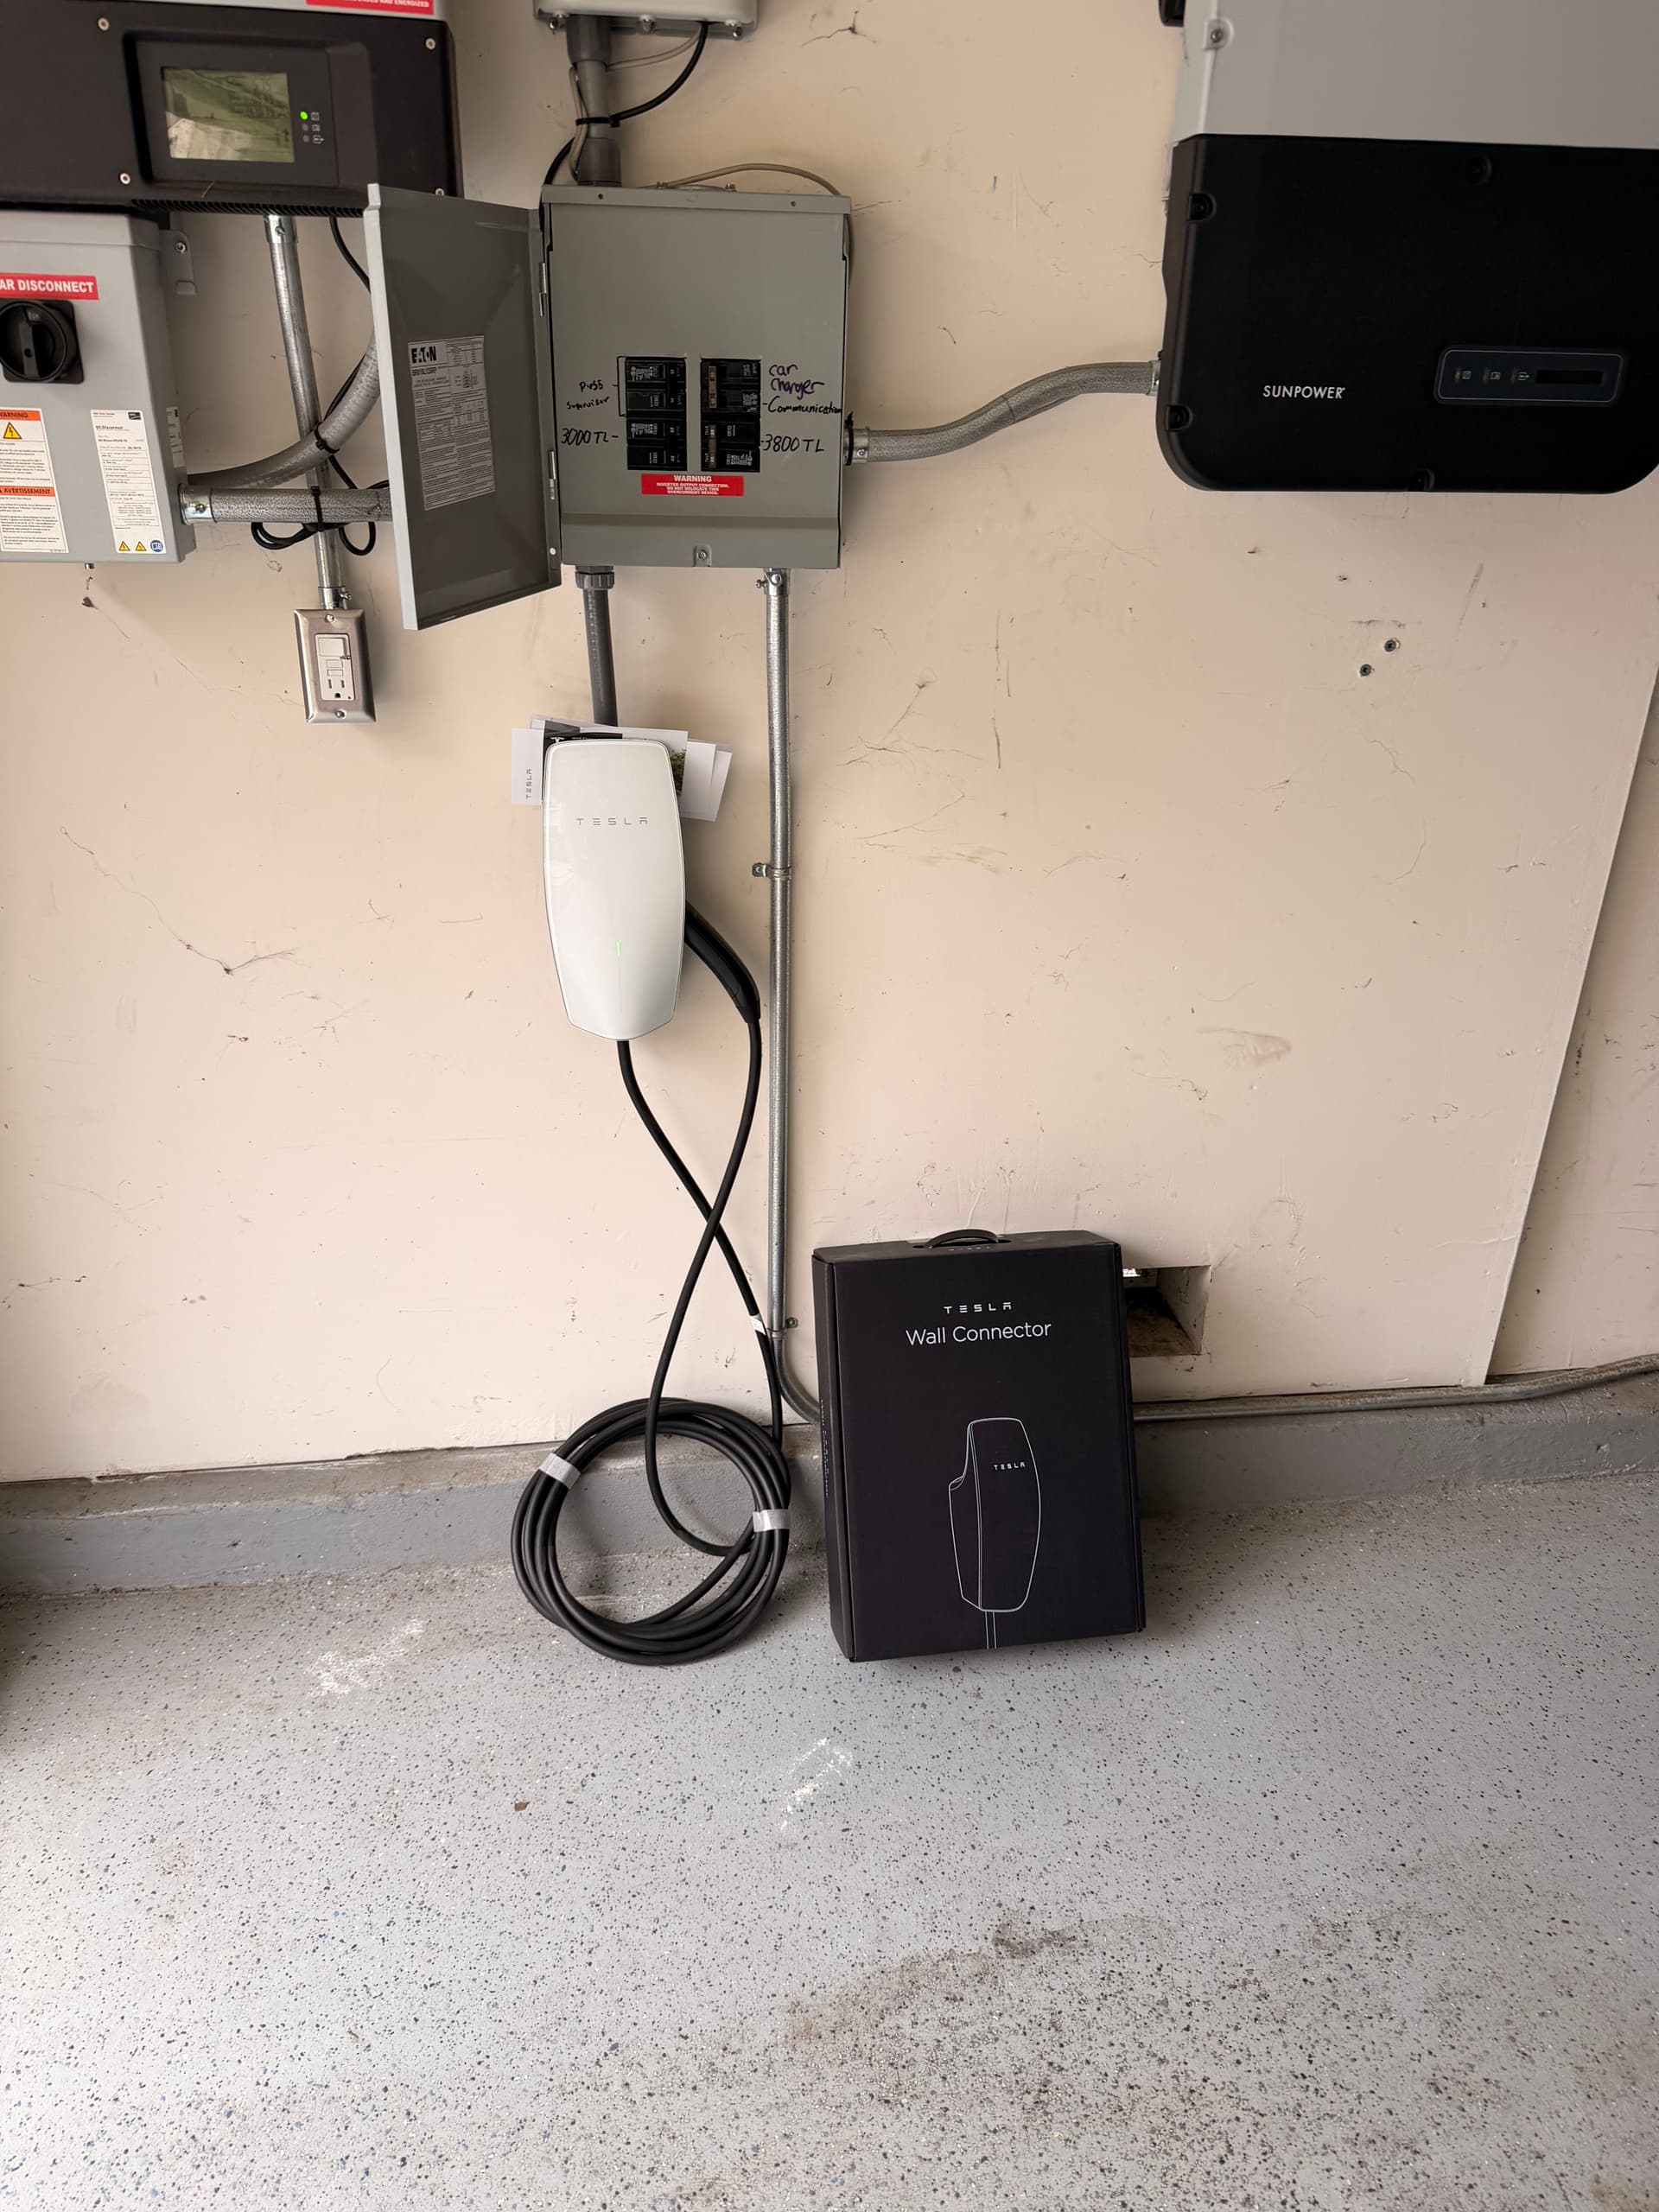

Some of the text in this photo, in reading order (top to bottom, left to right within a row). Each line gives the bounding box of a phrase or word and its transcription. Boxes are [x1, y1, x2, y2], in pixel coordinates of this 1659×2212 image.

[17, 279, 93, 293] DISCONNECT
[411, 346, 437, 364] EATON
[561, 428, 592, 446] 3000
[803, 439, 824, 452] TL
[575, 817, 648, 826] TESLA
[944, 1301, 1012, 1314] TESLA
[906, 1321, 1052, 1345] Wall Connector
[994, 1461, 1026, 1471] TESLA
